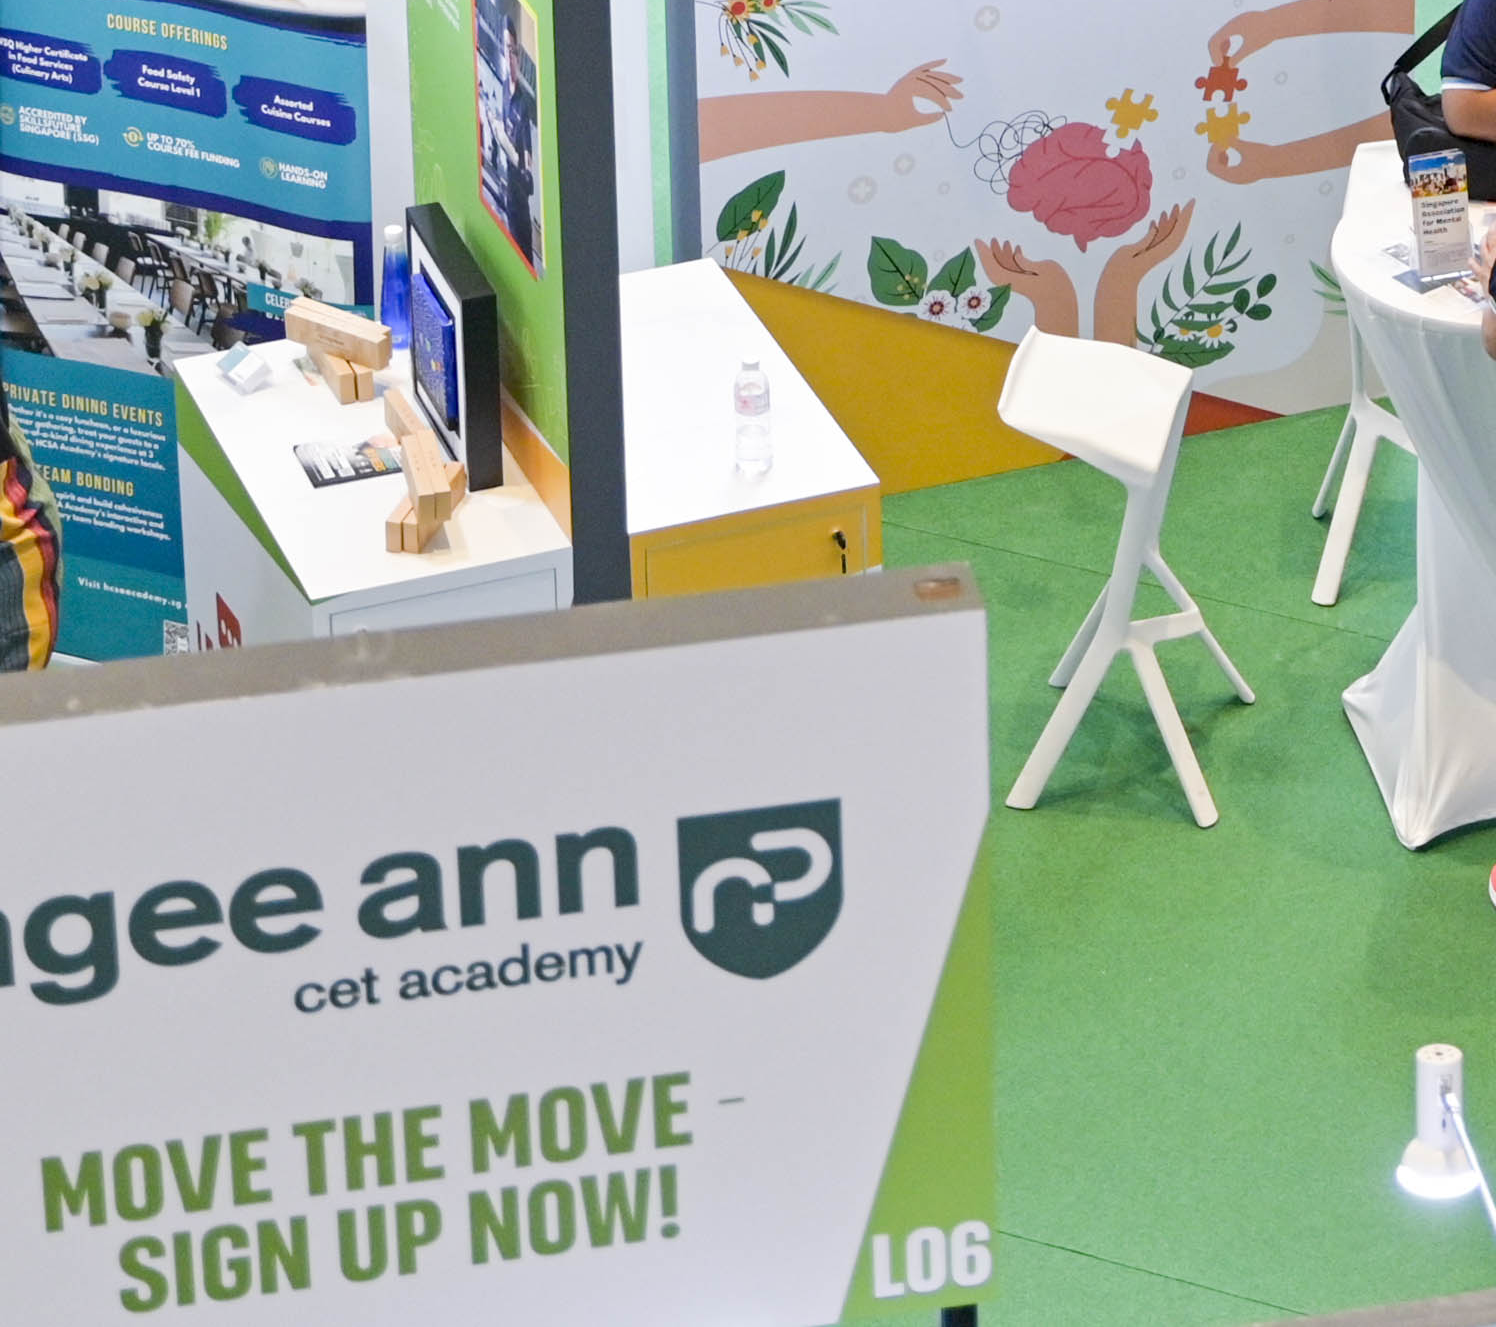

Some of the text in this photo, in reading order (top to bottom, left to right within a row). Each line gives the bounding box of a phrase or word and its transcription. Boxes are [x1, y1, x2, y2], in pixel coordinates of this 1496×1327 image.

[106, 13, 228, 51] COURSE OFFERINGS
[357, 826, 640, 940] ann
[293, 941, 643, 1014] cet academy
[40, 1071, 693, 1234] MOVE THE MOVE
[118, 1164, 680, 1314] SIGN UP NOW!
[870, 1218, 992, 1302] L06
